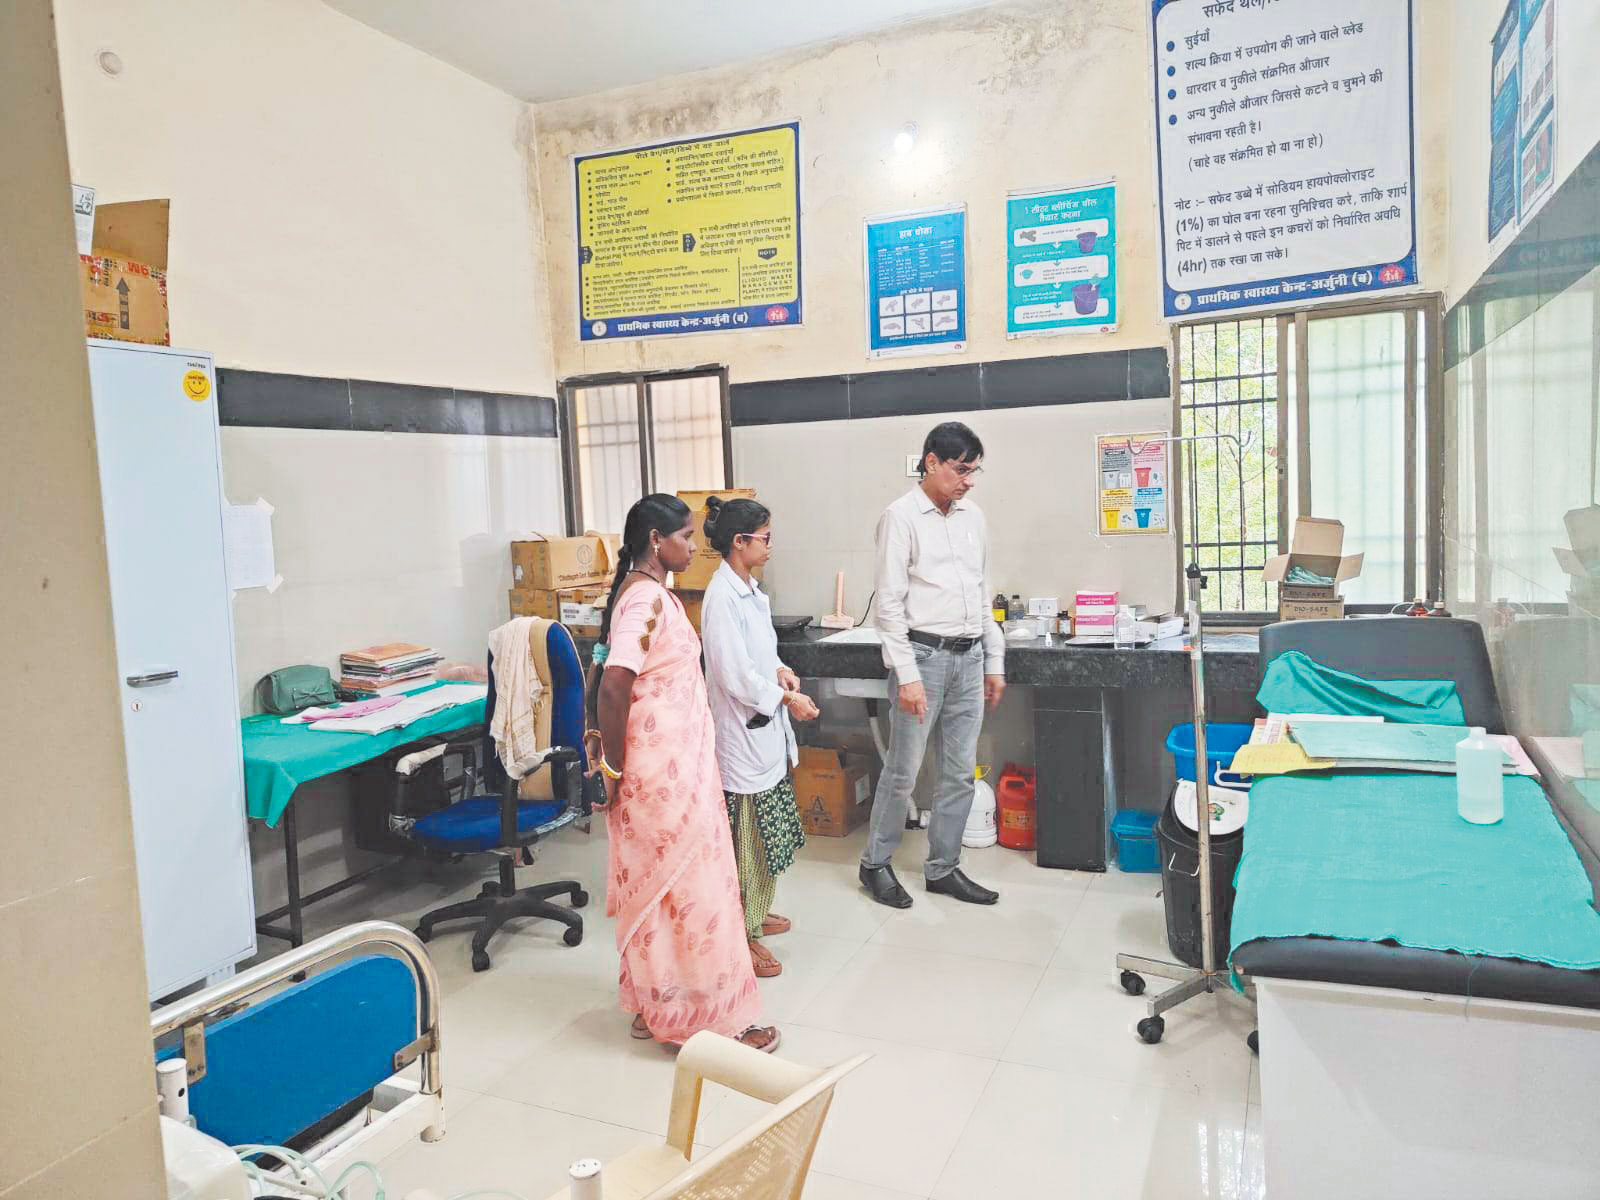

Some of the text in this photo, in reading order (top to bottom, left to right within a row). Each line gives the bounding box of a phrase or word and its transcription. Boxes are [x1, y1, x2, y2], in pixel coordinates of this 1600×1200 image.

[1202, 0, 1235, 18] सफेद
[1185, 58, 1206, 70] शल्य
[1210, 52, 1231, 65] क्रिया
[1246, 41, 1277, 56] उपयोग
[1281, 35, 1292, 49] की
[1296, 31, 1316, 45] जाने
[1320, 25, 1338, 39] वाले
[1342, 22, 1363, 35] ब्लेड
[1220, 78, 1226, 88] व
[1230, 69, 1257, 90] नुकीले
[1262, 62, 1295, 79] संक्रमित
[1300, 57, 1329, 71] औजार
[1187, 108, 1205, 120] अन्य
[1210, 98, 1235, 120] नुकीले
[1240, 95, 1268, 109] औजार
[1272, 85, 1301, 103] जिससे
[1304, 80, 1328, 95] कटने
[1333, 81, 1338, 90] व
[1369, 69, 1383, 83] की
[1188, 130, 1221, 144] संभावना
[1225, 124, 1246, 138] रहती
[1214, 154, 1226, 164] वह
[1229, 145, 1263, 161] संक्रमित
[1266, 141, 1276, 154] हो
[1280, 142, 1290, 152] या
[1175, 199, 1191, 210] नोट
[1209, 191, 1232, 204] सफेद
[1255, 185, 1263, 196] में
[1267, 180, 1303, 194] सोडियम
[1176, 216, 1204, 235] (1%)
[1208, 217, 1219, 227] का
[1245, 210, 1261, 220] बना
[1265, 206, 1286, 218] रहना
[1360, 188, 1383, 202] ताकि
[1205, 232, 1230, 247] डालने
[1234, 230, 1242, 242] से
[1245, 226, 1266, 241] पहले
[1270, 227, 1283, 238] इन
[1287, 220, 1312, 234] कचरों
[1317, 216, 1329, 230] को
[1375, 206, 1400, 220] अवधि
[1178, 258, 1207, 276] (4hr)
[1210, 258, 1226, 268] तक
[1230, 255, 1247, 265] रखा
[1251, 253, 1262, 262] जा
[1197, 290, 1241, 306] प्राथमिक
